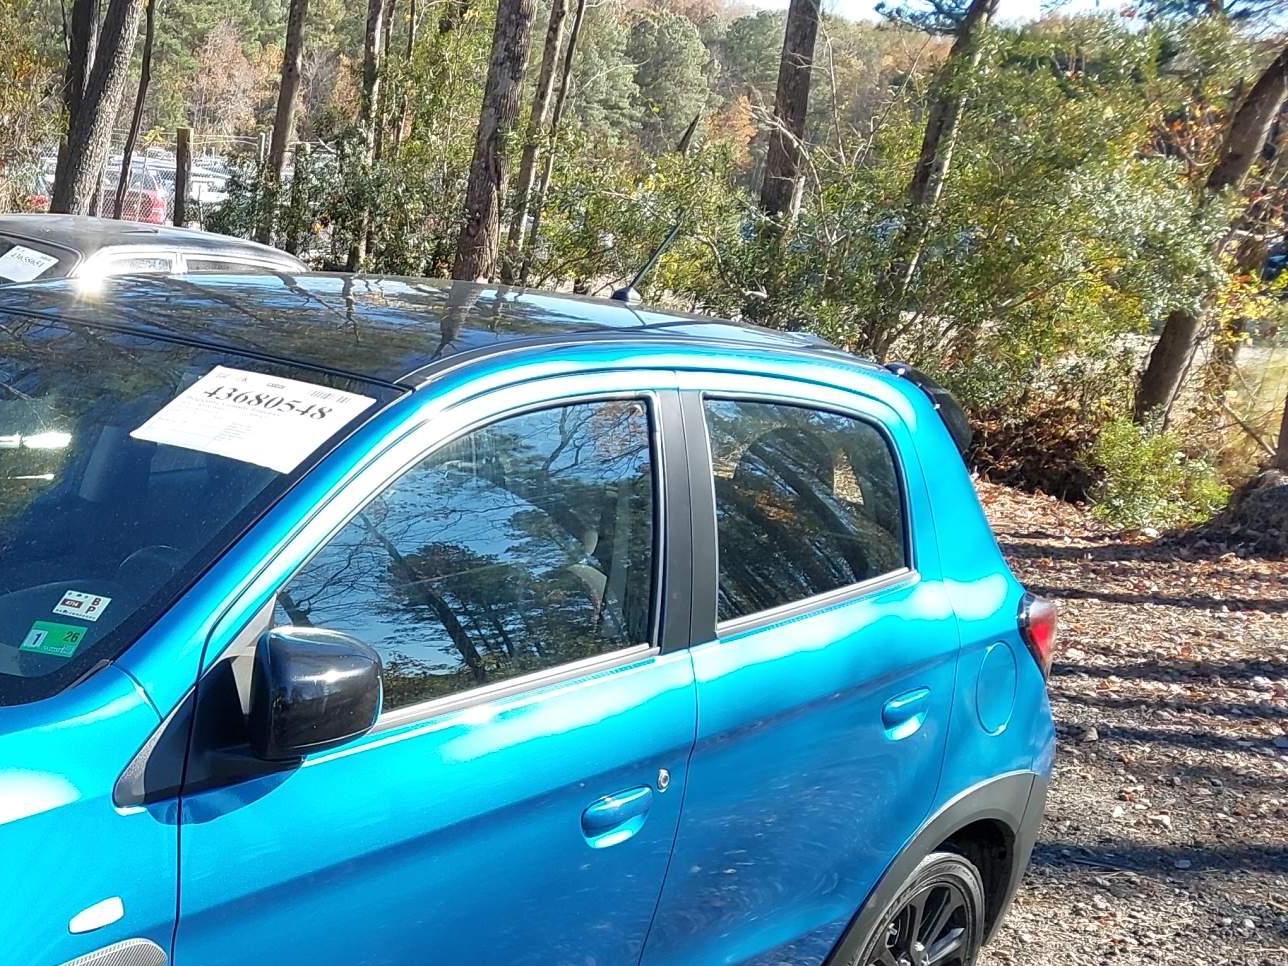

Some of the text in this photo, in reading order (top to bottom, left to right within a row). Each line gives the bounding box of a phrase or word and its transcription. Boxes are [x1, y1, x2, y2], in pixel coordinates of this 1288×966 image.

[203, 385, 333, 420] 43680548
[85, 606, 96, 614] P
[32, 632, 43, 646] 1
[63, 631, 80, 643] 26
